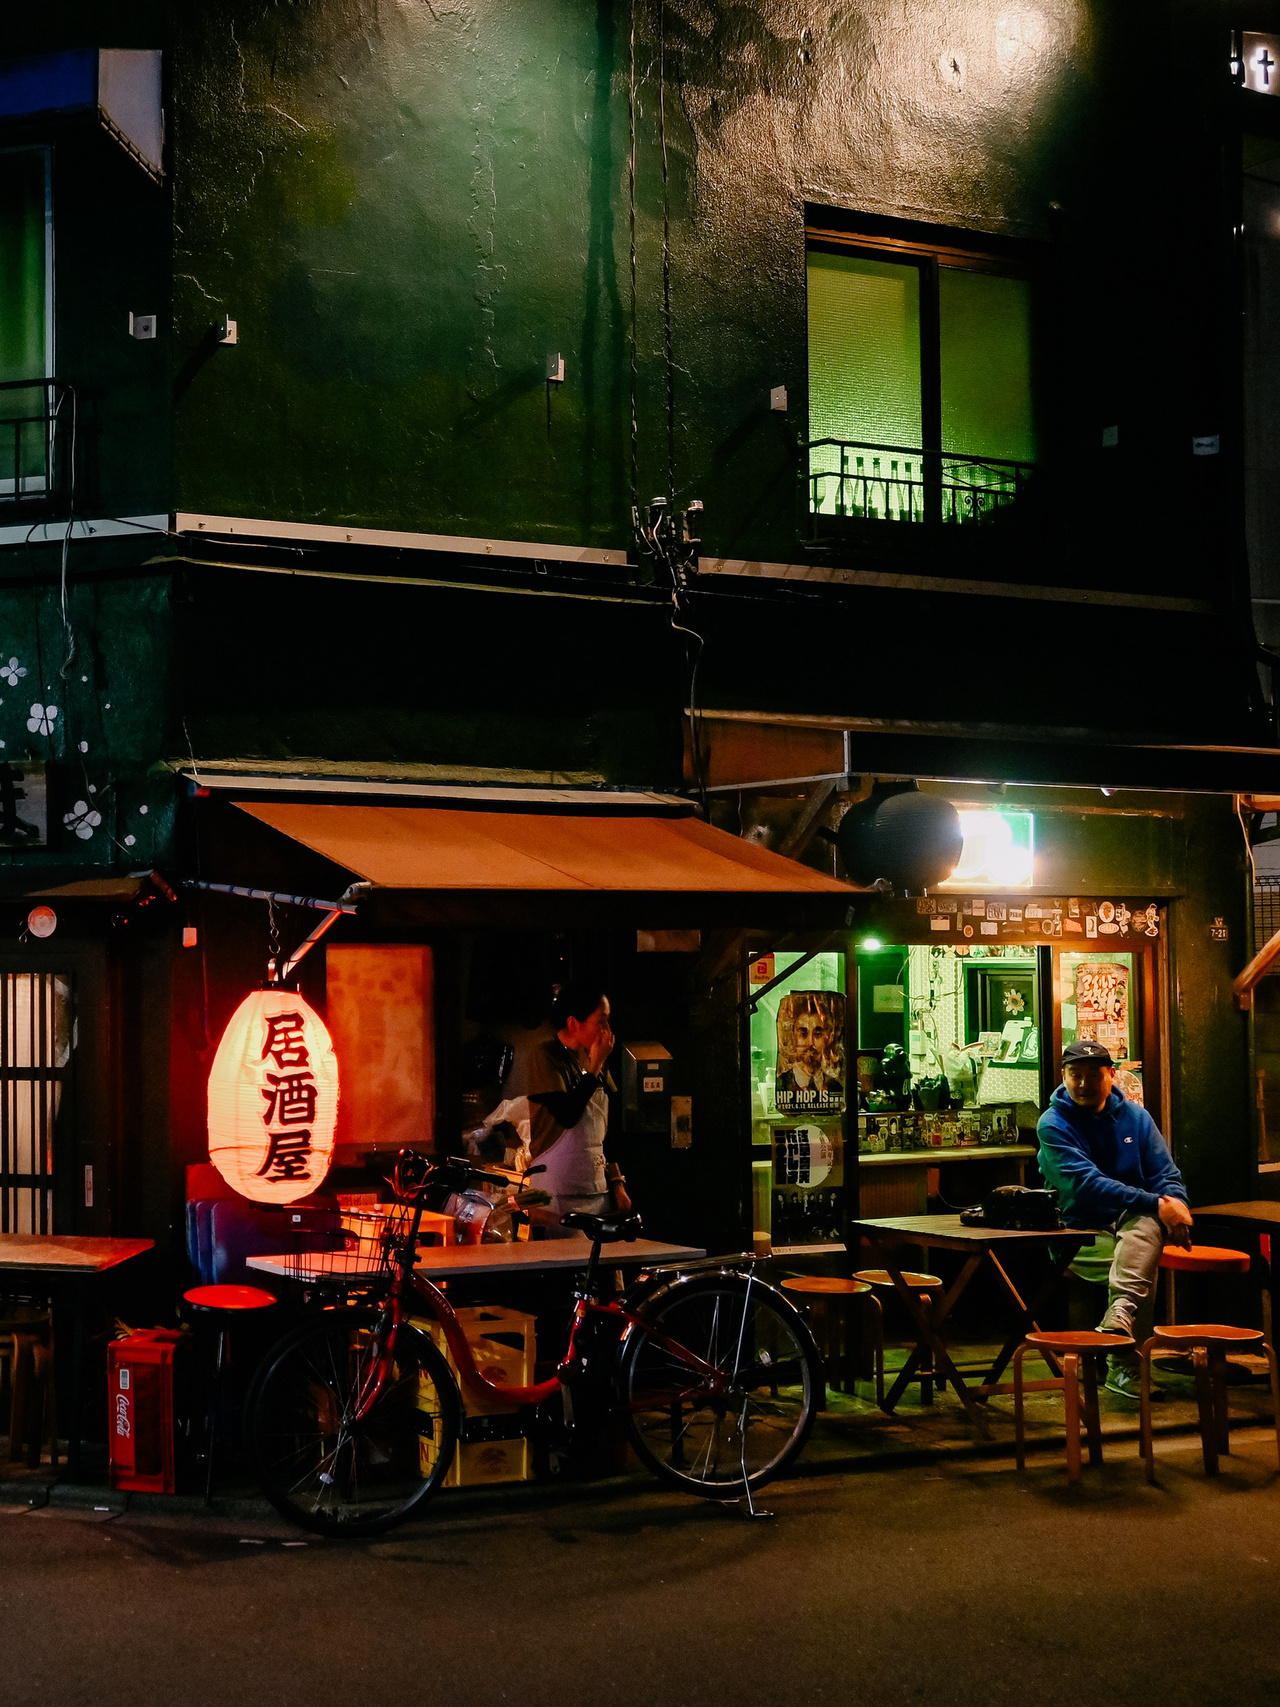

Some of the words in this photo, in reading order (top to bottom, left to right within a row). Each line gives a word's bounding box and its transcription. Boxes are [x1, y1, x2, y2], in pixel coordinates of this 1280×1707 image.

[257, 1012, 318, 1183] 居酒屋
[776, 1090, 794, 1104] HIP
[796, 1089, 816, 1103] HOP
[115, 1393, 131, 1439] Coca-Cola
